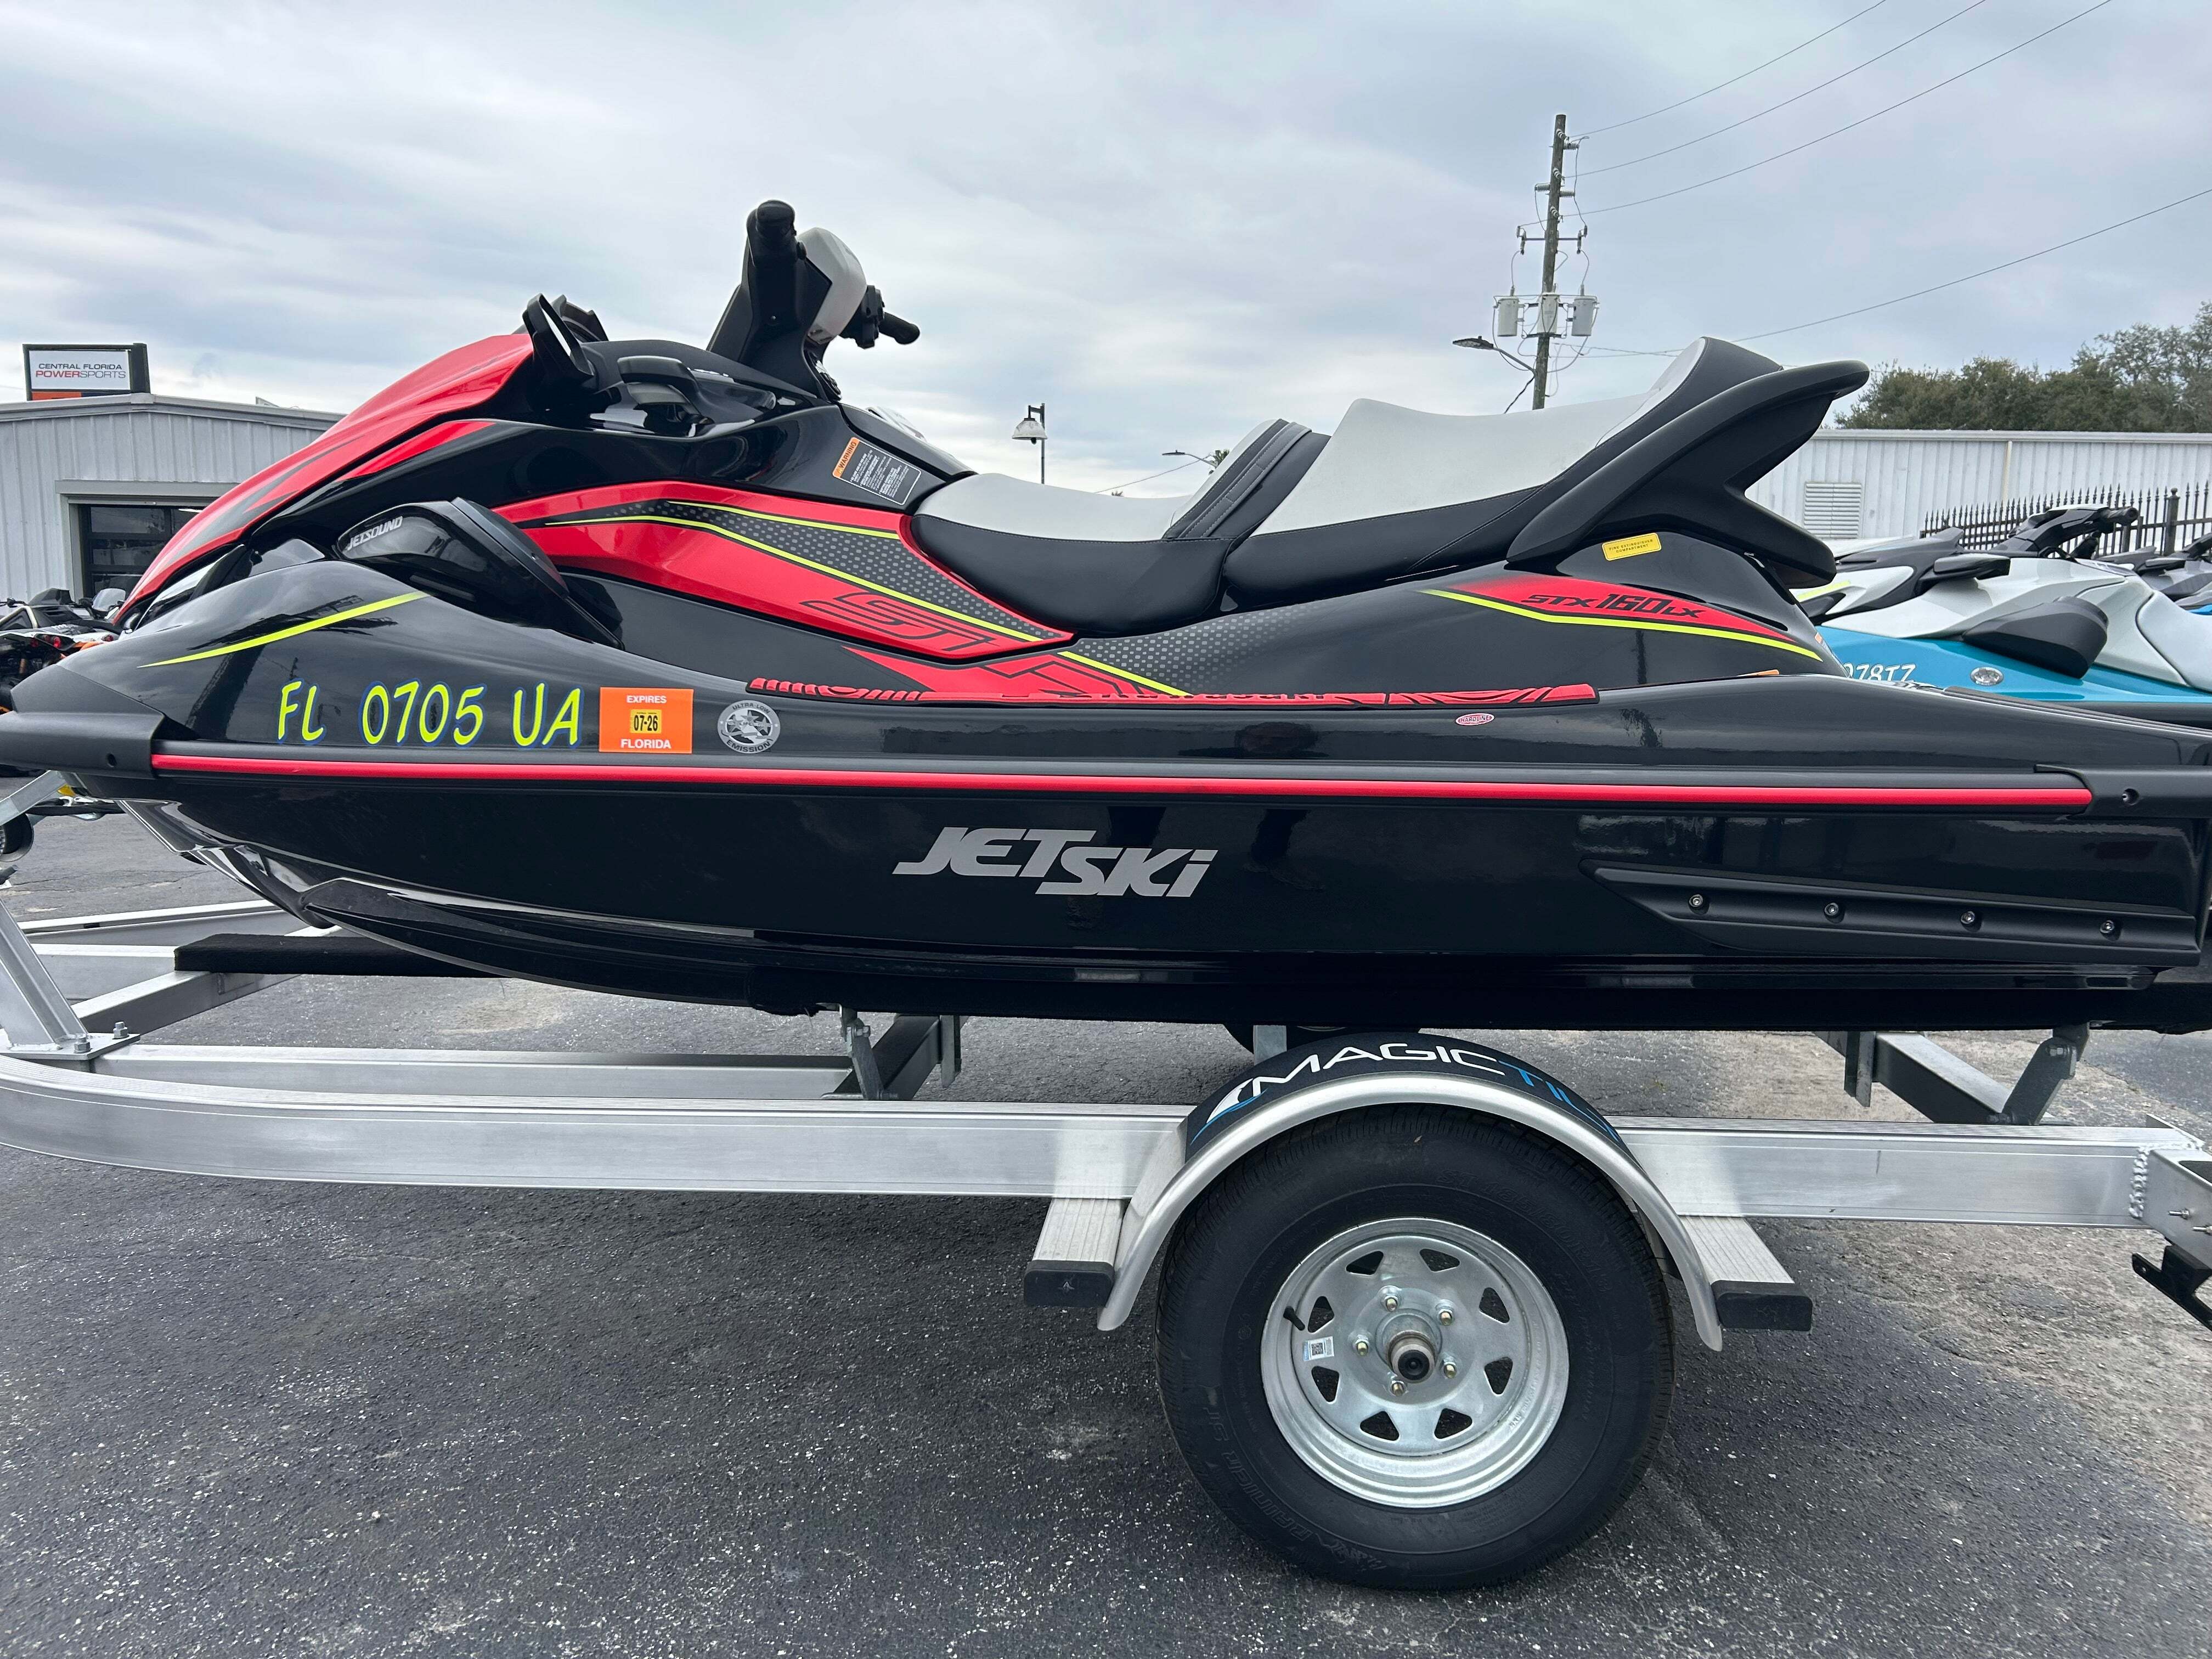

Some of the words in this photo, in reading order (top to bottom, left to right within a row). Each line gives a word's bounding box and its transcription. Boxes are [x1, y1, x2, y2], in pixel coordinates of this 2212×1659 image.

[36, 370, 126, 379] POWERSPORTS
[838, 442, 857, 469] WARNING
[346, 516, 403, 550] JETSOUND
[1616, 544, 1649, 553] COMPARTMENT
[1521, 594, 1595, 608] STX
[627, 695, 667, 704] EXPIRES
[278, 680, 324, 741] FL
[362, 680, 484, 745] 0705
[514, 682, 582, 746] UA
[732, 702, 754, 710] ULTRA
[757, 704, 771, 714] LOW
[634, 714, 658, 731] 07-26
[620, 739, 672, 749] FLORIDA
[726, 740, 771, 753] EMISSION
